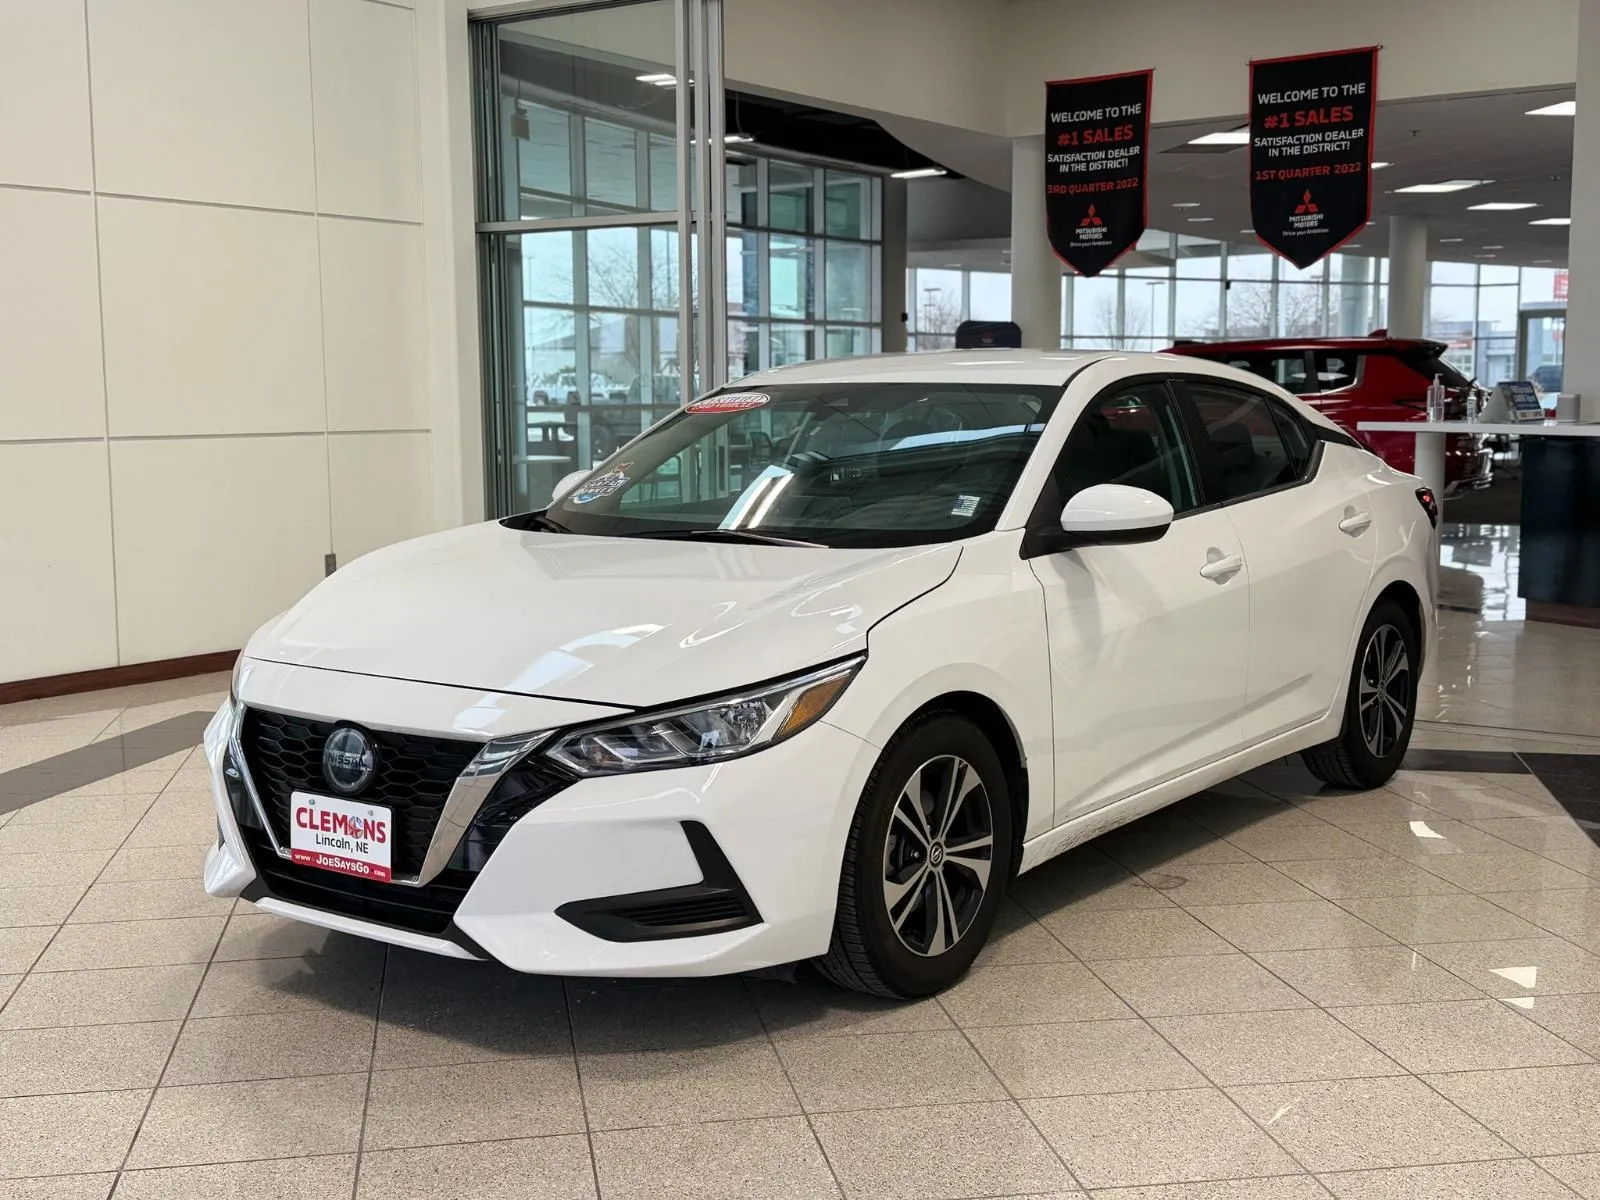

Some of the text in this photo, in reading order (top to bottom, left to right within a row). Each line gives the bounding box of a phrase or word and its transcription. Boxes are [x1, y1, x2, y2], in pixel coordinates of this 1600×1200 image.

[1257, 83, 1366, 105] WELCOME TO THE
[1050, 103, 1142, 123] WELCOME TO THE
[1263, 106, 1354, 129] #1 SALES
[1057, 124, 1134, 146] #1 SALES
[1254, 128, 1364, 147] SATISFACTION DEALER
[1047, 146, 1140, 163] SATISFACTION DEALER
[1268, 141, 1350, 157] IN THE DISTRICT!
[1060, 158, 1129, 173] IN THE DISTRICT!
[1255, 162, 1361, 181] 1ST QUARTER 2022
[1047, 178, 1139, 195] 3RD QUARTER 2022
[1289, 213, 1324, 222] MITSUBISHI
[1294, 220, 1318, 228] MOTORS
[329, 752, 365, 768] NISSAN
[296, 807, 386, 844] CLEMONS
[315, 833, 369, 854] Lincoln, NE
